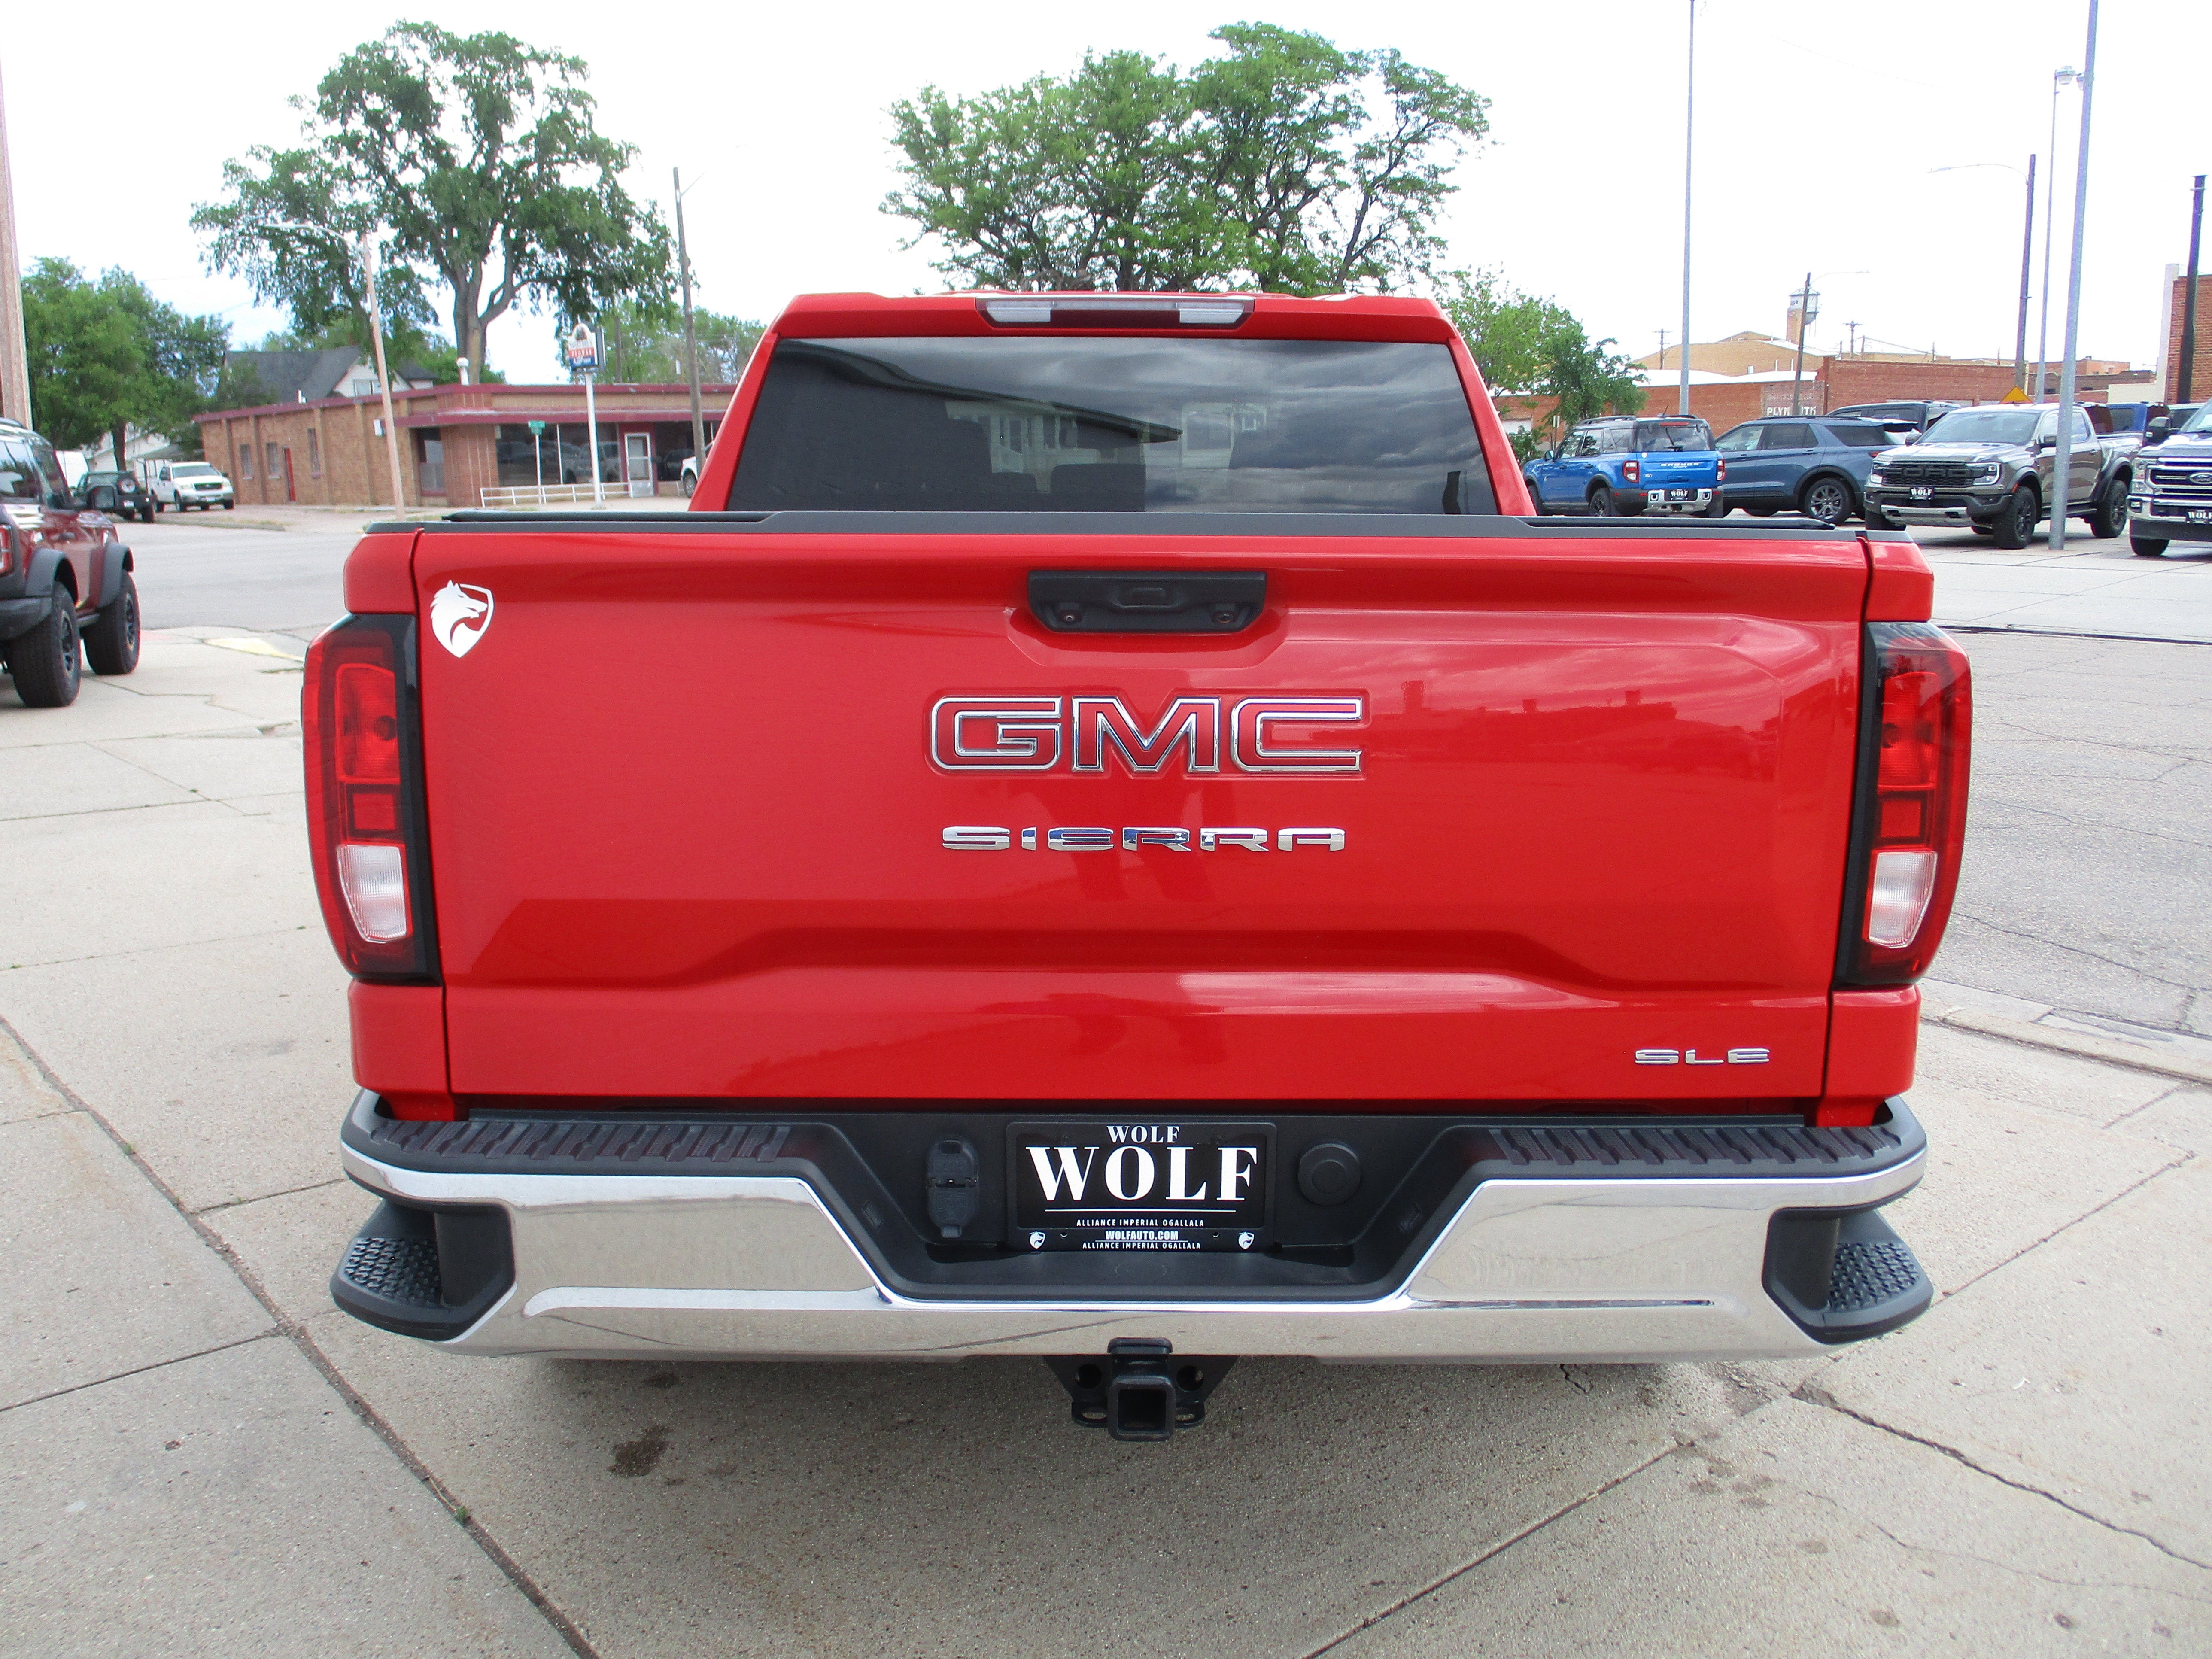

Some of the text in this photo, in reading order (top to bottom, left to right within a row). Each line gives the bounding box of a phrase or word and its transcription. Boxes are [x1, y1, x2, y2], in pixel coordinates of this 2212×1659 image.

[1767, 406, 1816, 416] PLYMTH
[931, 696, 1363, 772] GMC
[942, 826, 1346, 852] SIERRA
[1635, 1048, 1770, 1064] SLE
[1106, 1126, 1180, 1143] WOLF
[1025, 1146, 1258, 1201] WOLF
[1105, 1231, 1179, 1240] WOLFAUTO.COM
